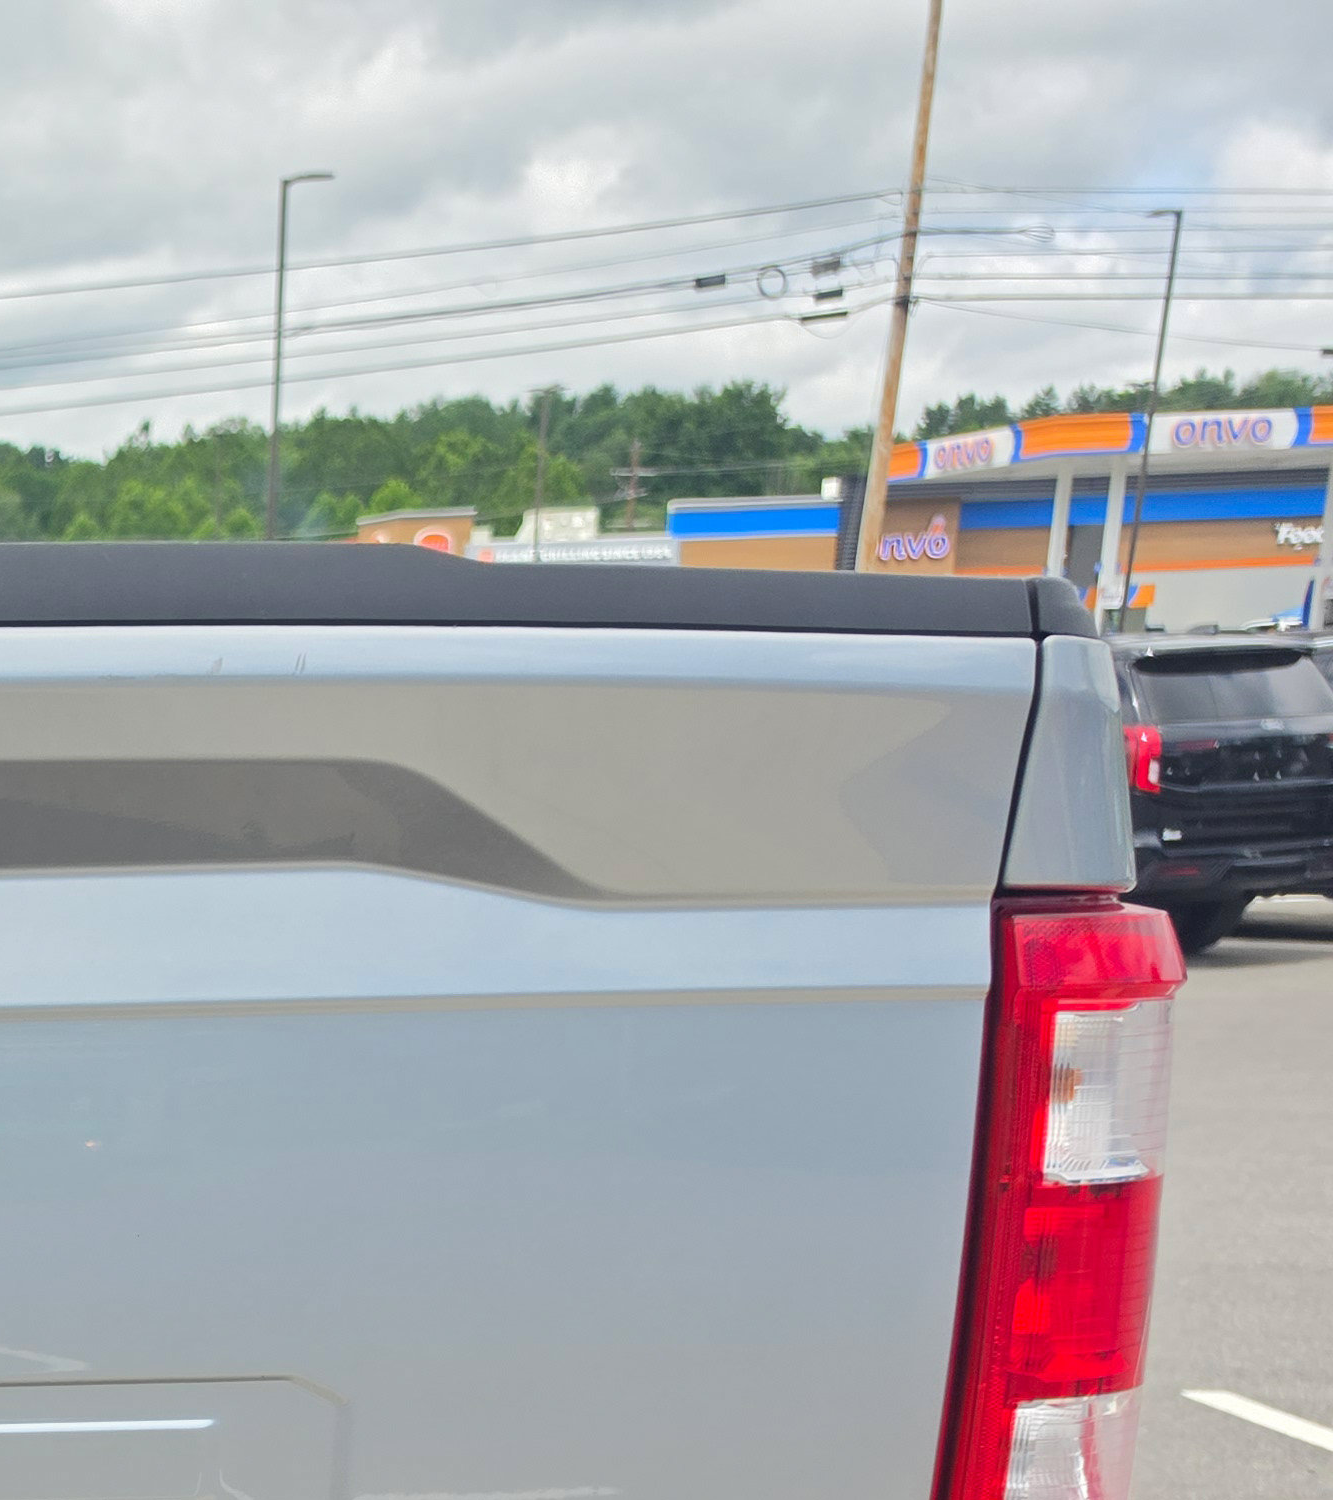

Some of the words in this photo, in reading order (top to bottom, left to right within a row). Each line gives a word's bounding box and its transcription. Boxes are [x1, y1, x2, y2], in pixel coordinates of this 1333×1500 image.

[1171, 416, 1273, 448] onvo
[934, 437, 995, 470] onvo
[876, 531, 950, 561] nvo
